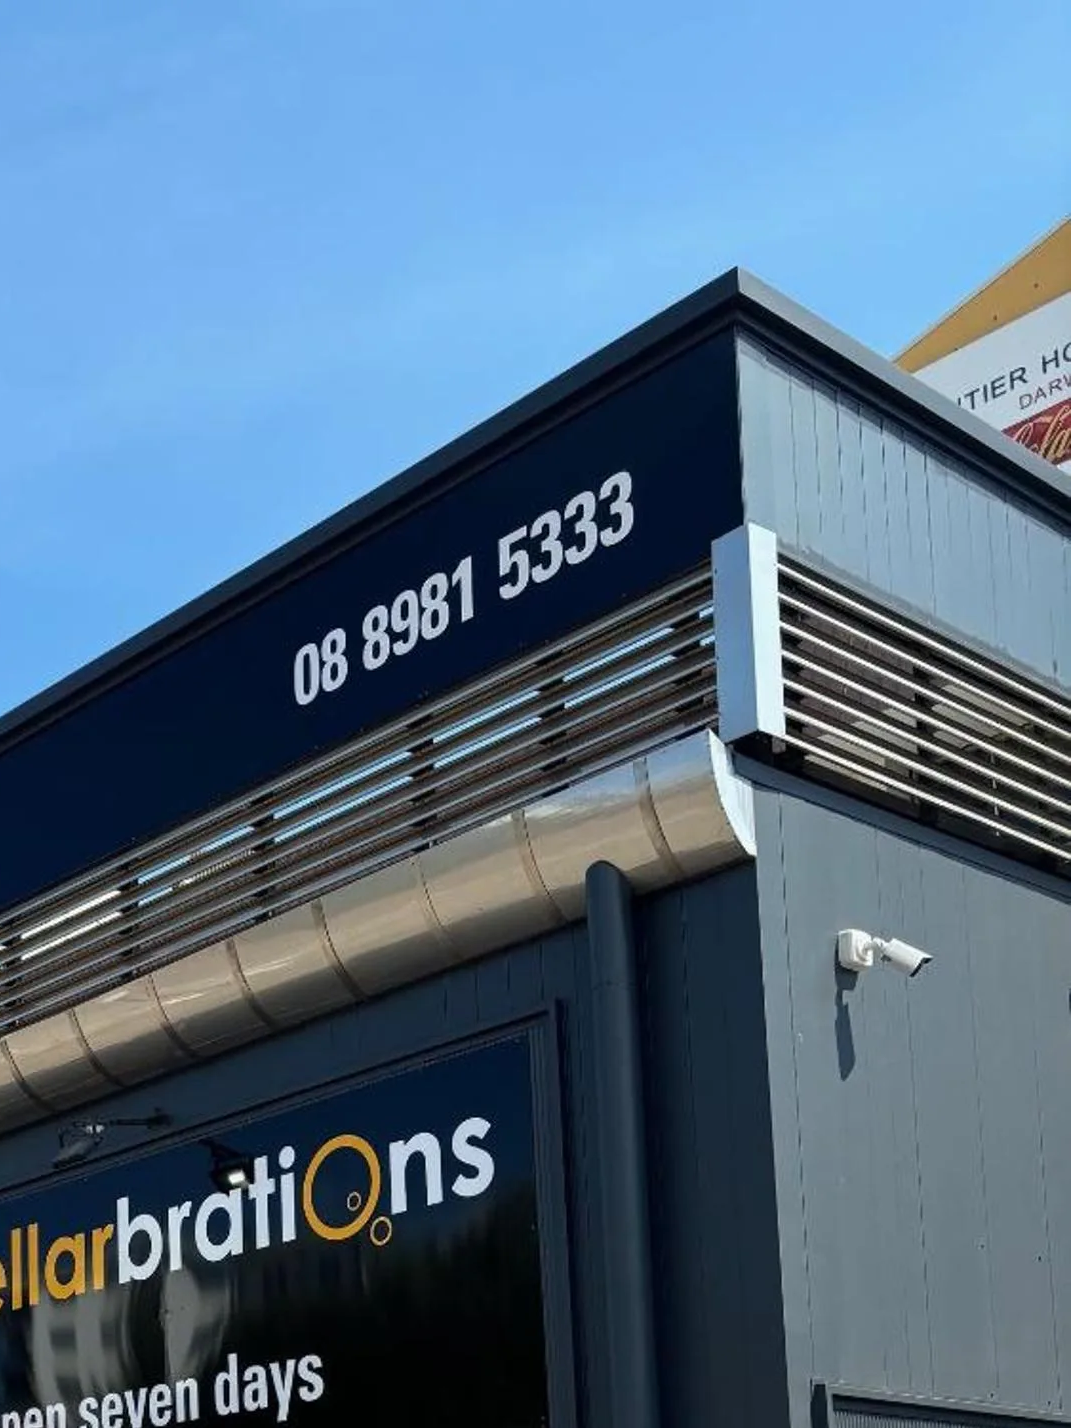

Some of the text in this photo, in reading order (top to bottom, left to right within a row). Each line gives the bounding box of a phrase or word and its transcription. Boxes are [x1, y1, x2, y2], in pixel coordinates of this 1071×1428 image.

[294, 471, 634, 705] 08 8981 5333
[214, 1353, 324, 1423] days
